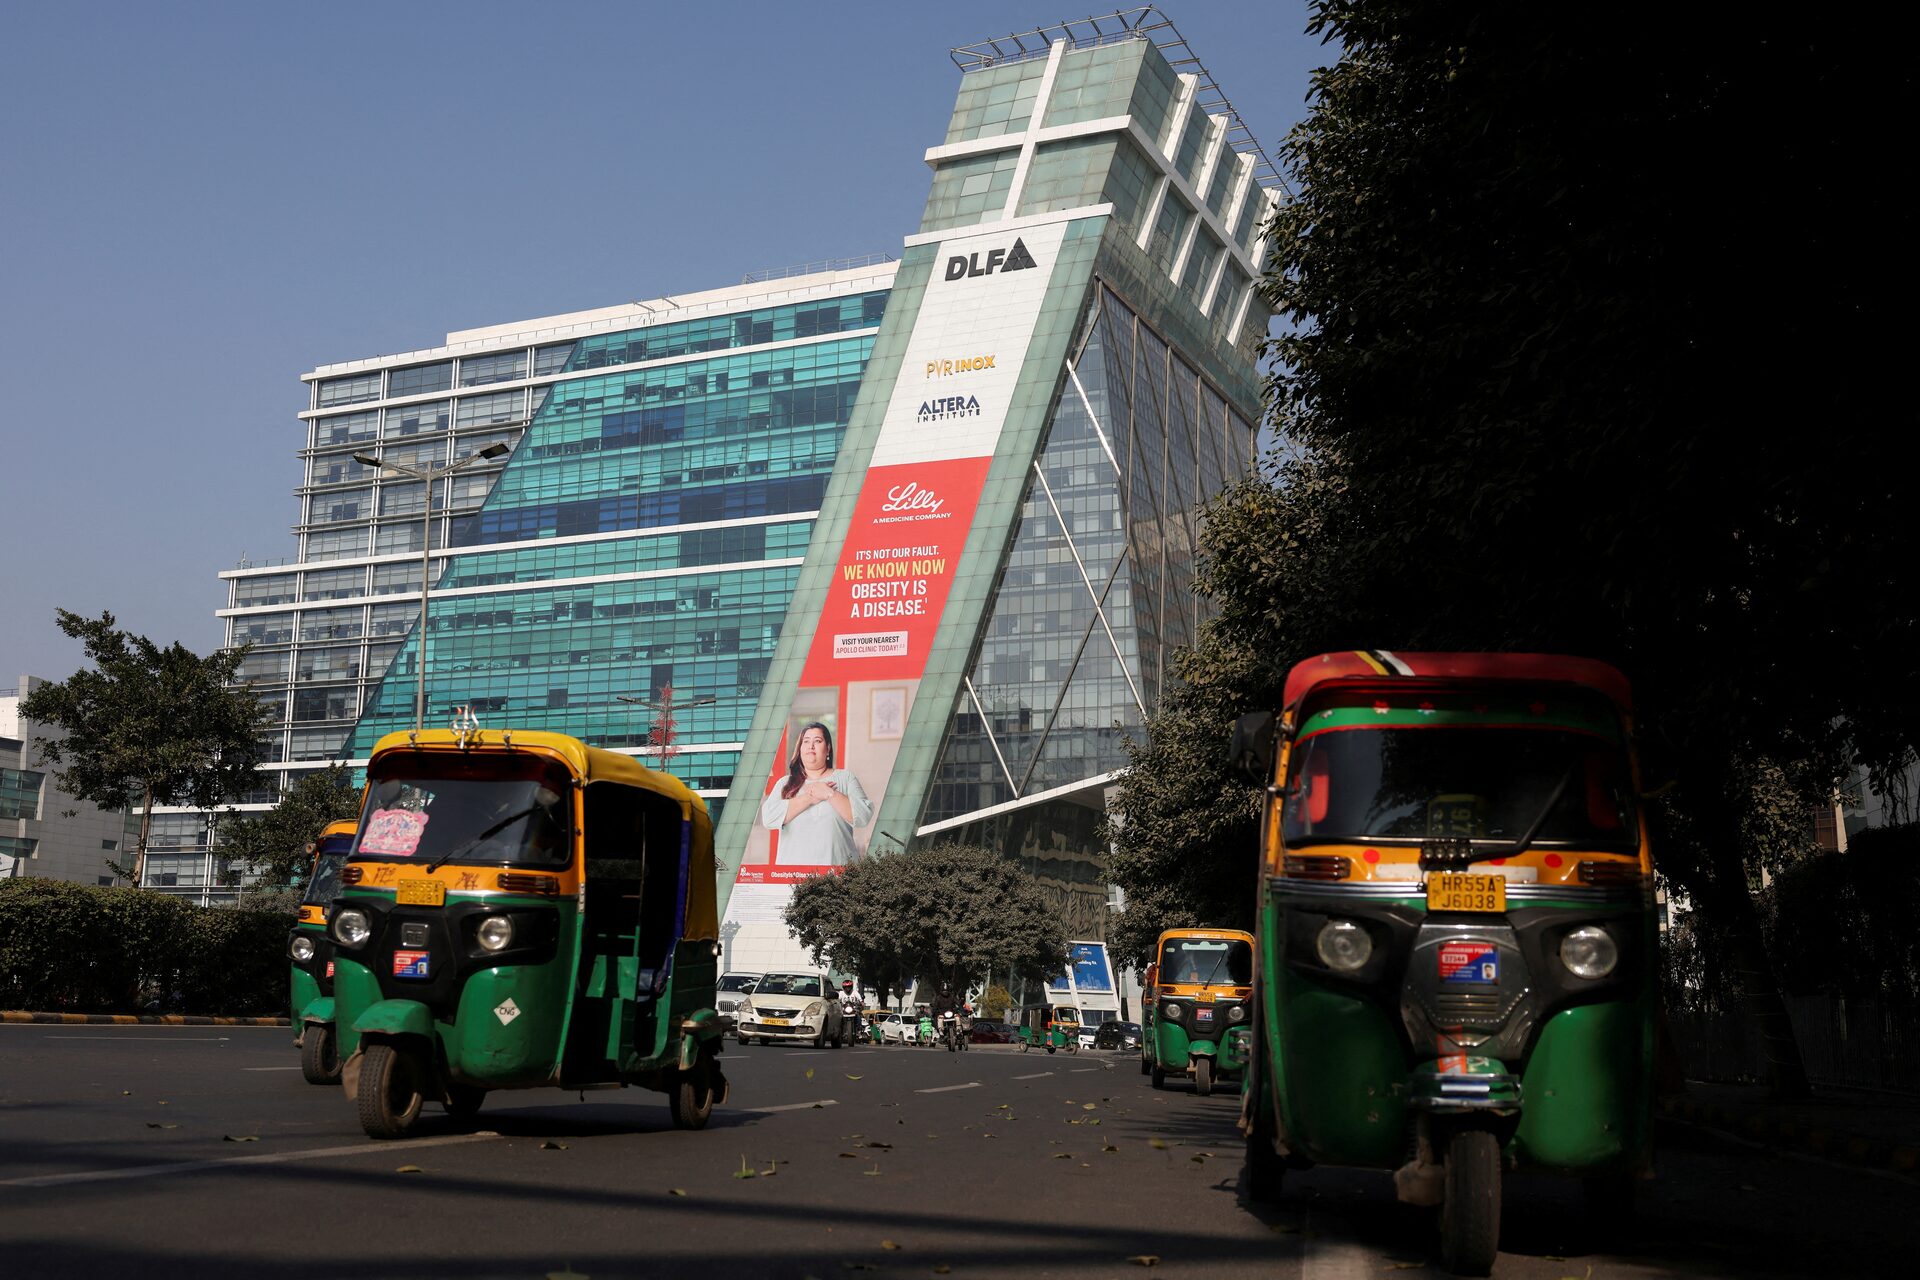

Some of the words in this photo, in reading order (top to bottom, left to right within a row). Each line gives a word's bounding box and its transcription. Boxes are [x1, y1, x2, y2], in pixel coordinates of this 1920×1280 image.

[944, 248, 1006, 282] DLF
[926, 359, 953, 379] PVR
[955, 354, 996, 373] INOX
[918, 394, 980, 415] ALTERA
[917, 408, 980, 423] INSTITUTE
[882, 482, 944, 513] Lilly
[879, 515, 914, 524] MEDICINE
[915, 512, 951, 521] COMPANY
[856, 550, 872, 561] IT'S
[873, 549, 891, 560] NOT
[892, 547, 910, 558] OUR
[912, 545, 940, 557] FAULT.
[843, 564, 864, 581] WE
[867, 561, 908, 579] KNOW
[912, 558, 946, 576] NOW
[851, 580, 910, 599] OBESITY
[913, 579, 927, 595] IS
[850, 603, 860, 618] A
[857, 637, 873, 645] YOUR
[873, 635, 900, 644] NEAREST
[858, 645, 878, 653] CLINIC
[1442, 876, 1496, 892] HR55A
[1441, 894, 1496, 909] J6038
